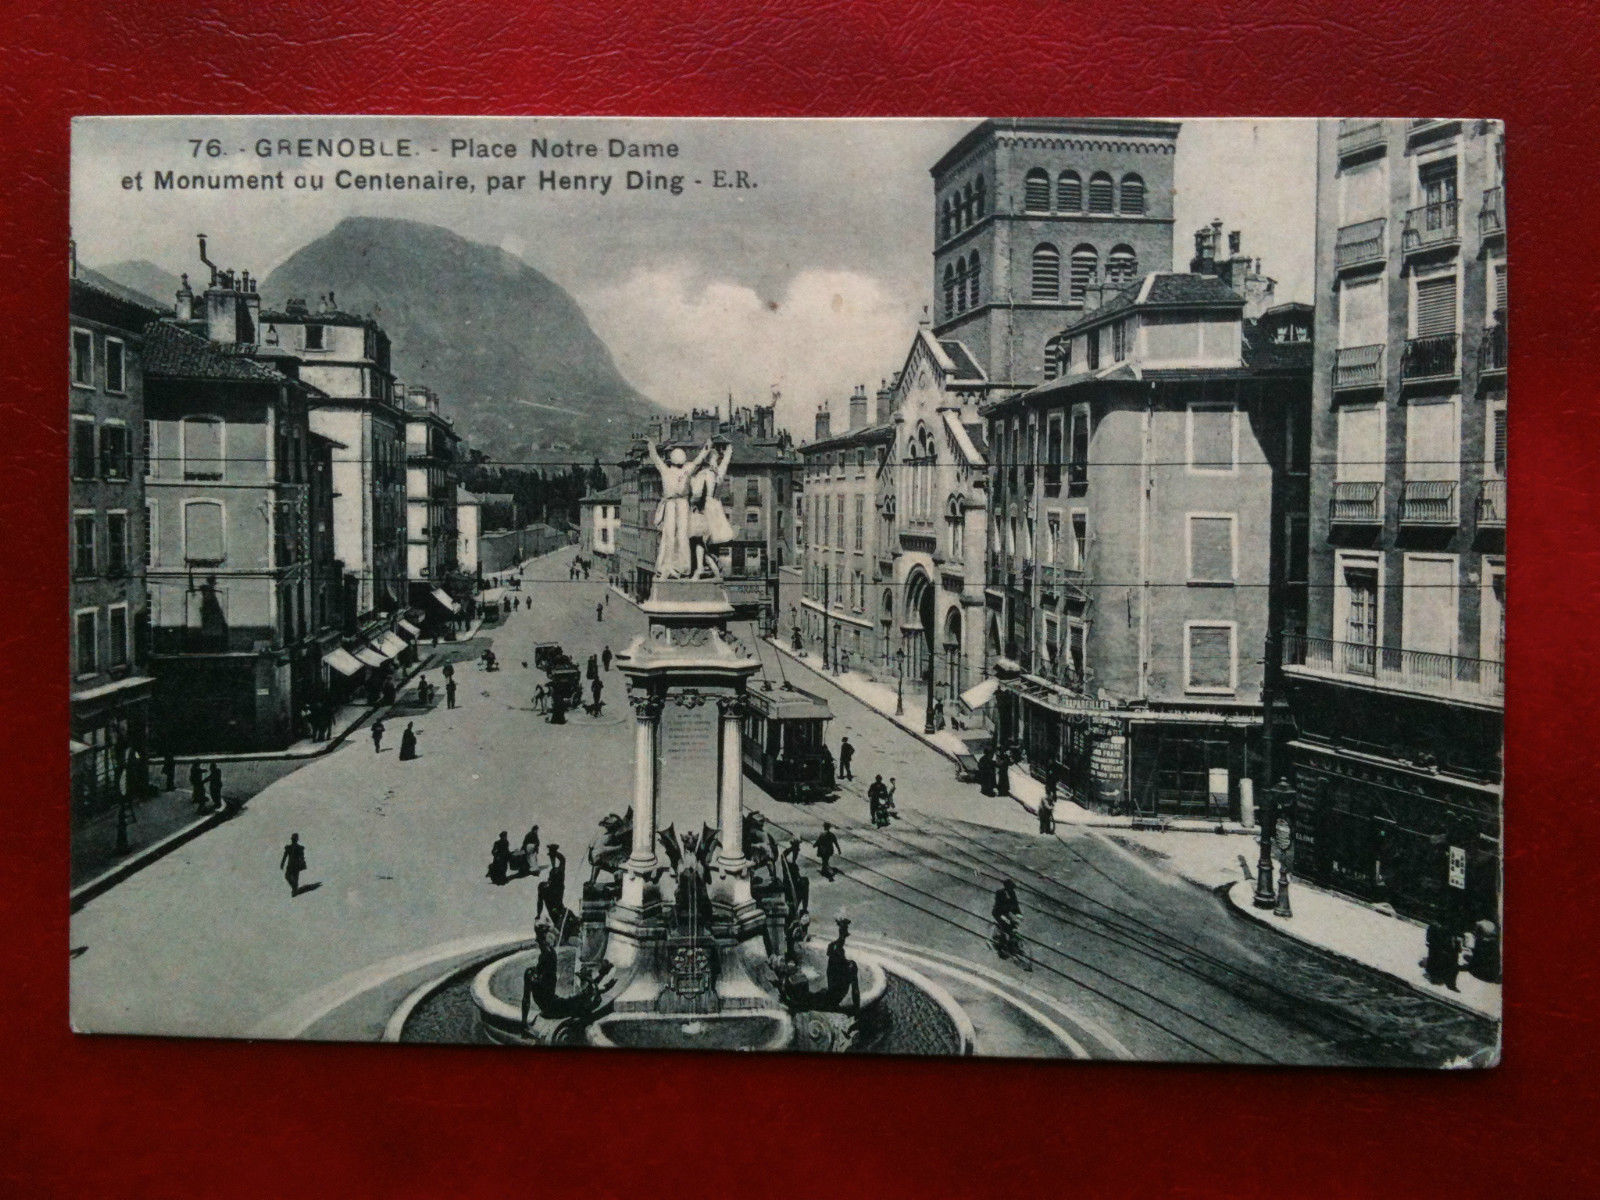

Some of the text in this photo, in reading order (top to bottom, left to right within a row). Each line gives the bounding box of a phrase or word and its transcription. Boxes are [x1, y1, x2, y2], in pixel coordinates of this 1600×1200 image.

[187, 137, 227, 159] 76.
[253, 137, 420, 159] GRENOBLE.
[450, 138, 518, 159] Place
[529, 136, 599, 159] Notre
[607, 137, 680, 159] Dame
[120, 170, 144, 193] et
[153, 169, 285, 193] Monument
[334, 168, 476, 194] Centenaire,
[486, 174, 527, 196] par
[537, 169, 613, 197] Henry
[625, 169, 686, 197] Ding
[712, 168, 759, 189] E.R.
